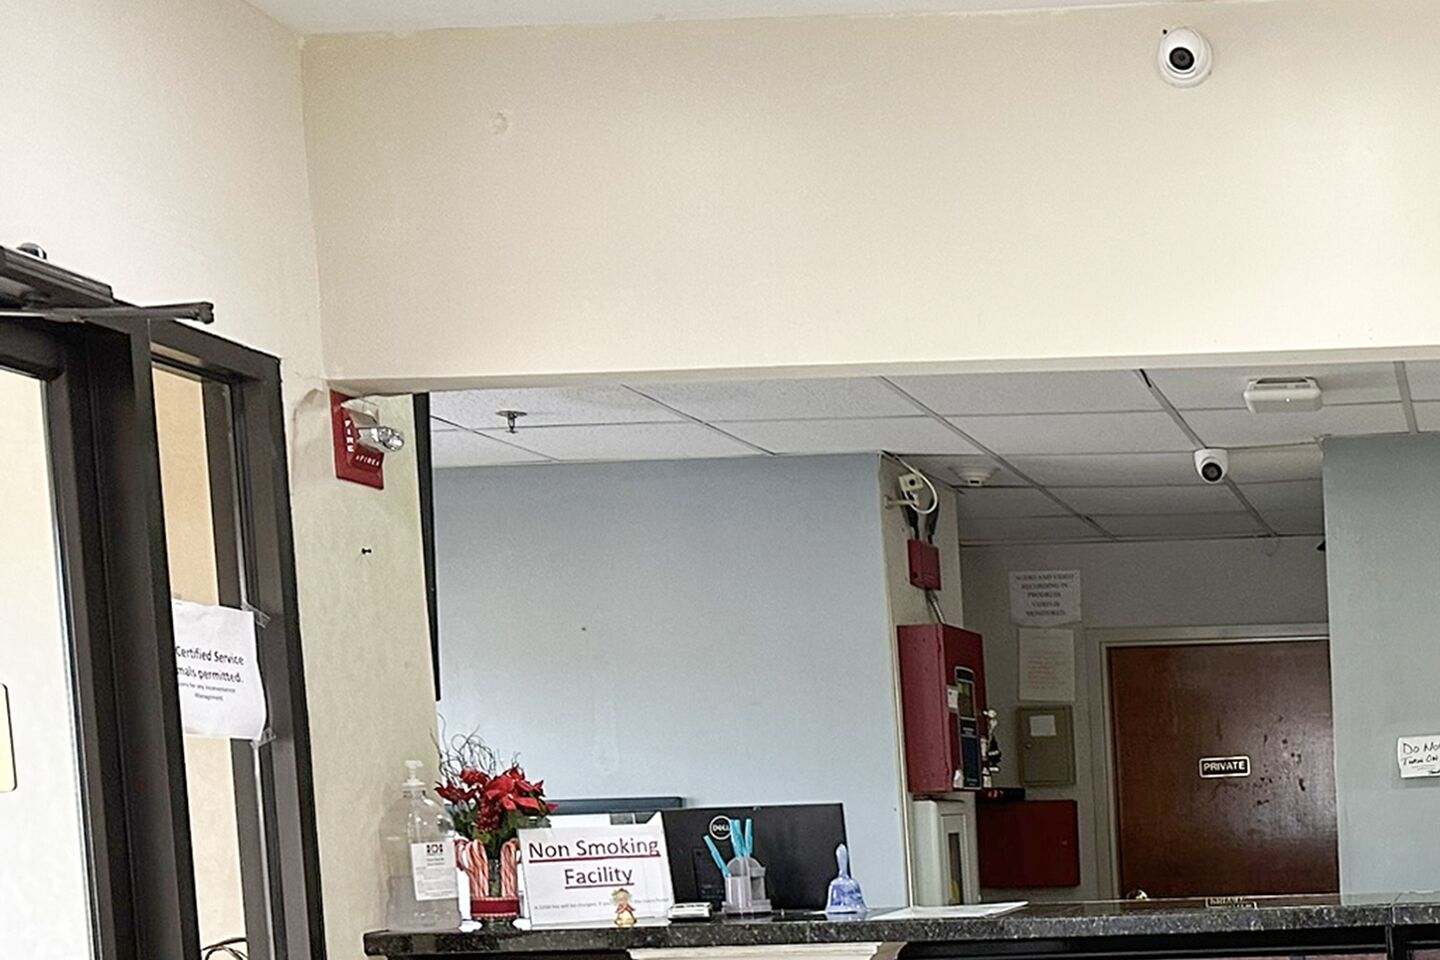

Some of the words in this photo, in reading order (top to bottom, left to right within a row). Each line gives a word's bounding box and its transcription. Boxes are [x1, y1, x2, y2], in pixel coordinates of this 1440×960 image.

[175, 645, 212, 661] Certified
[214, 650, 244, 666] Service
[1403, 742, 1420, 755] Do
[1203, 761, 1246, 771] PRIVATE
[529, 843, 570, 858] Non
[576, 837, 660, 857] Smoking
[564, 866, 633, 885] Facility
